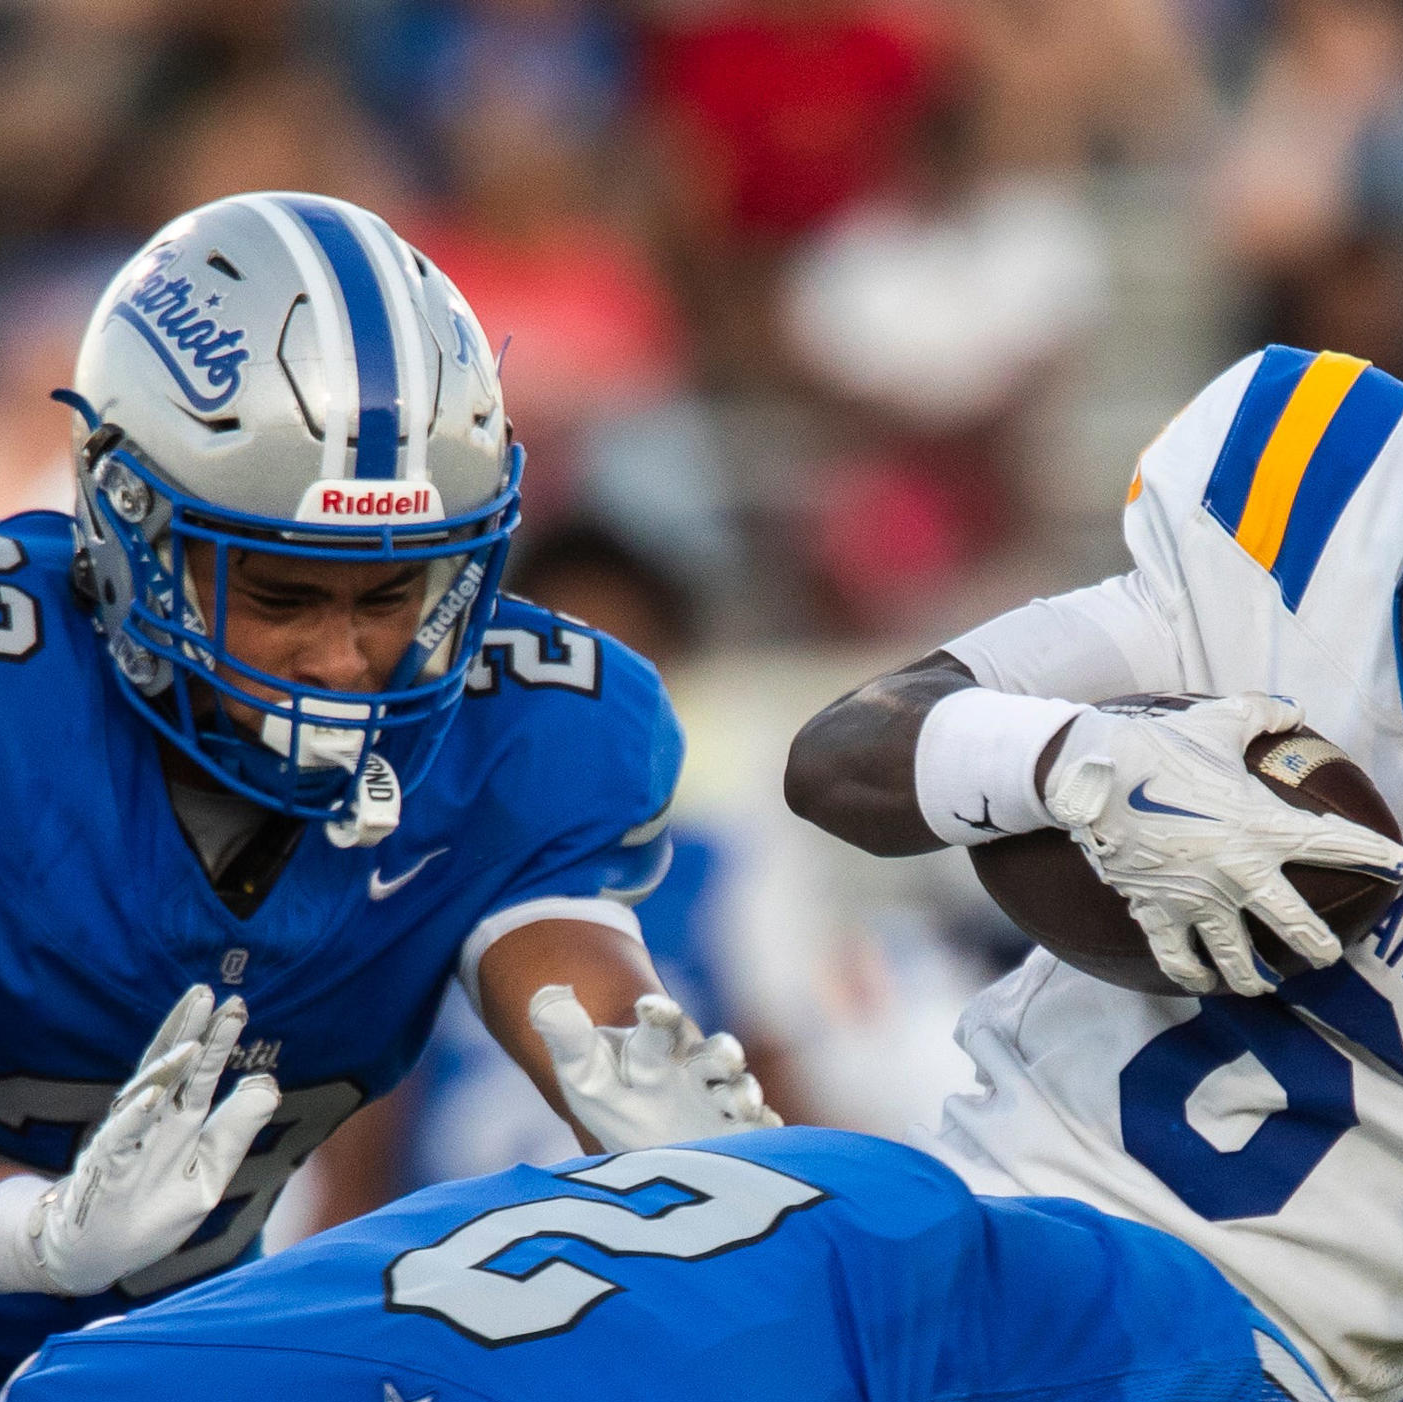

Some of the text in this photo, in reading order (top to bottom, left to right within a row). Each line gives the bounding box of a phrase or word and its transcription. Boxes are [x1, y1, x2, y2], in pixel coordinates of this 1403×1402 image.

[321, 489, 430, 515] Riddell
[415, 561, 485, 651] Riddell
[386, 1147, 827, 1348] 2
